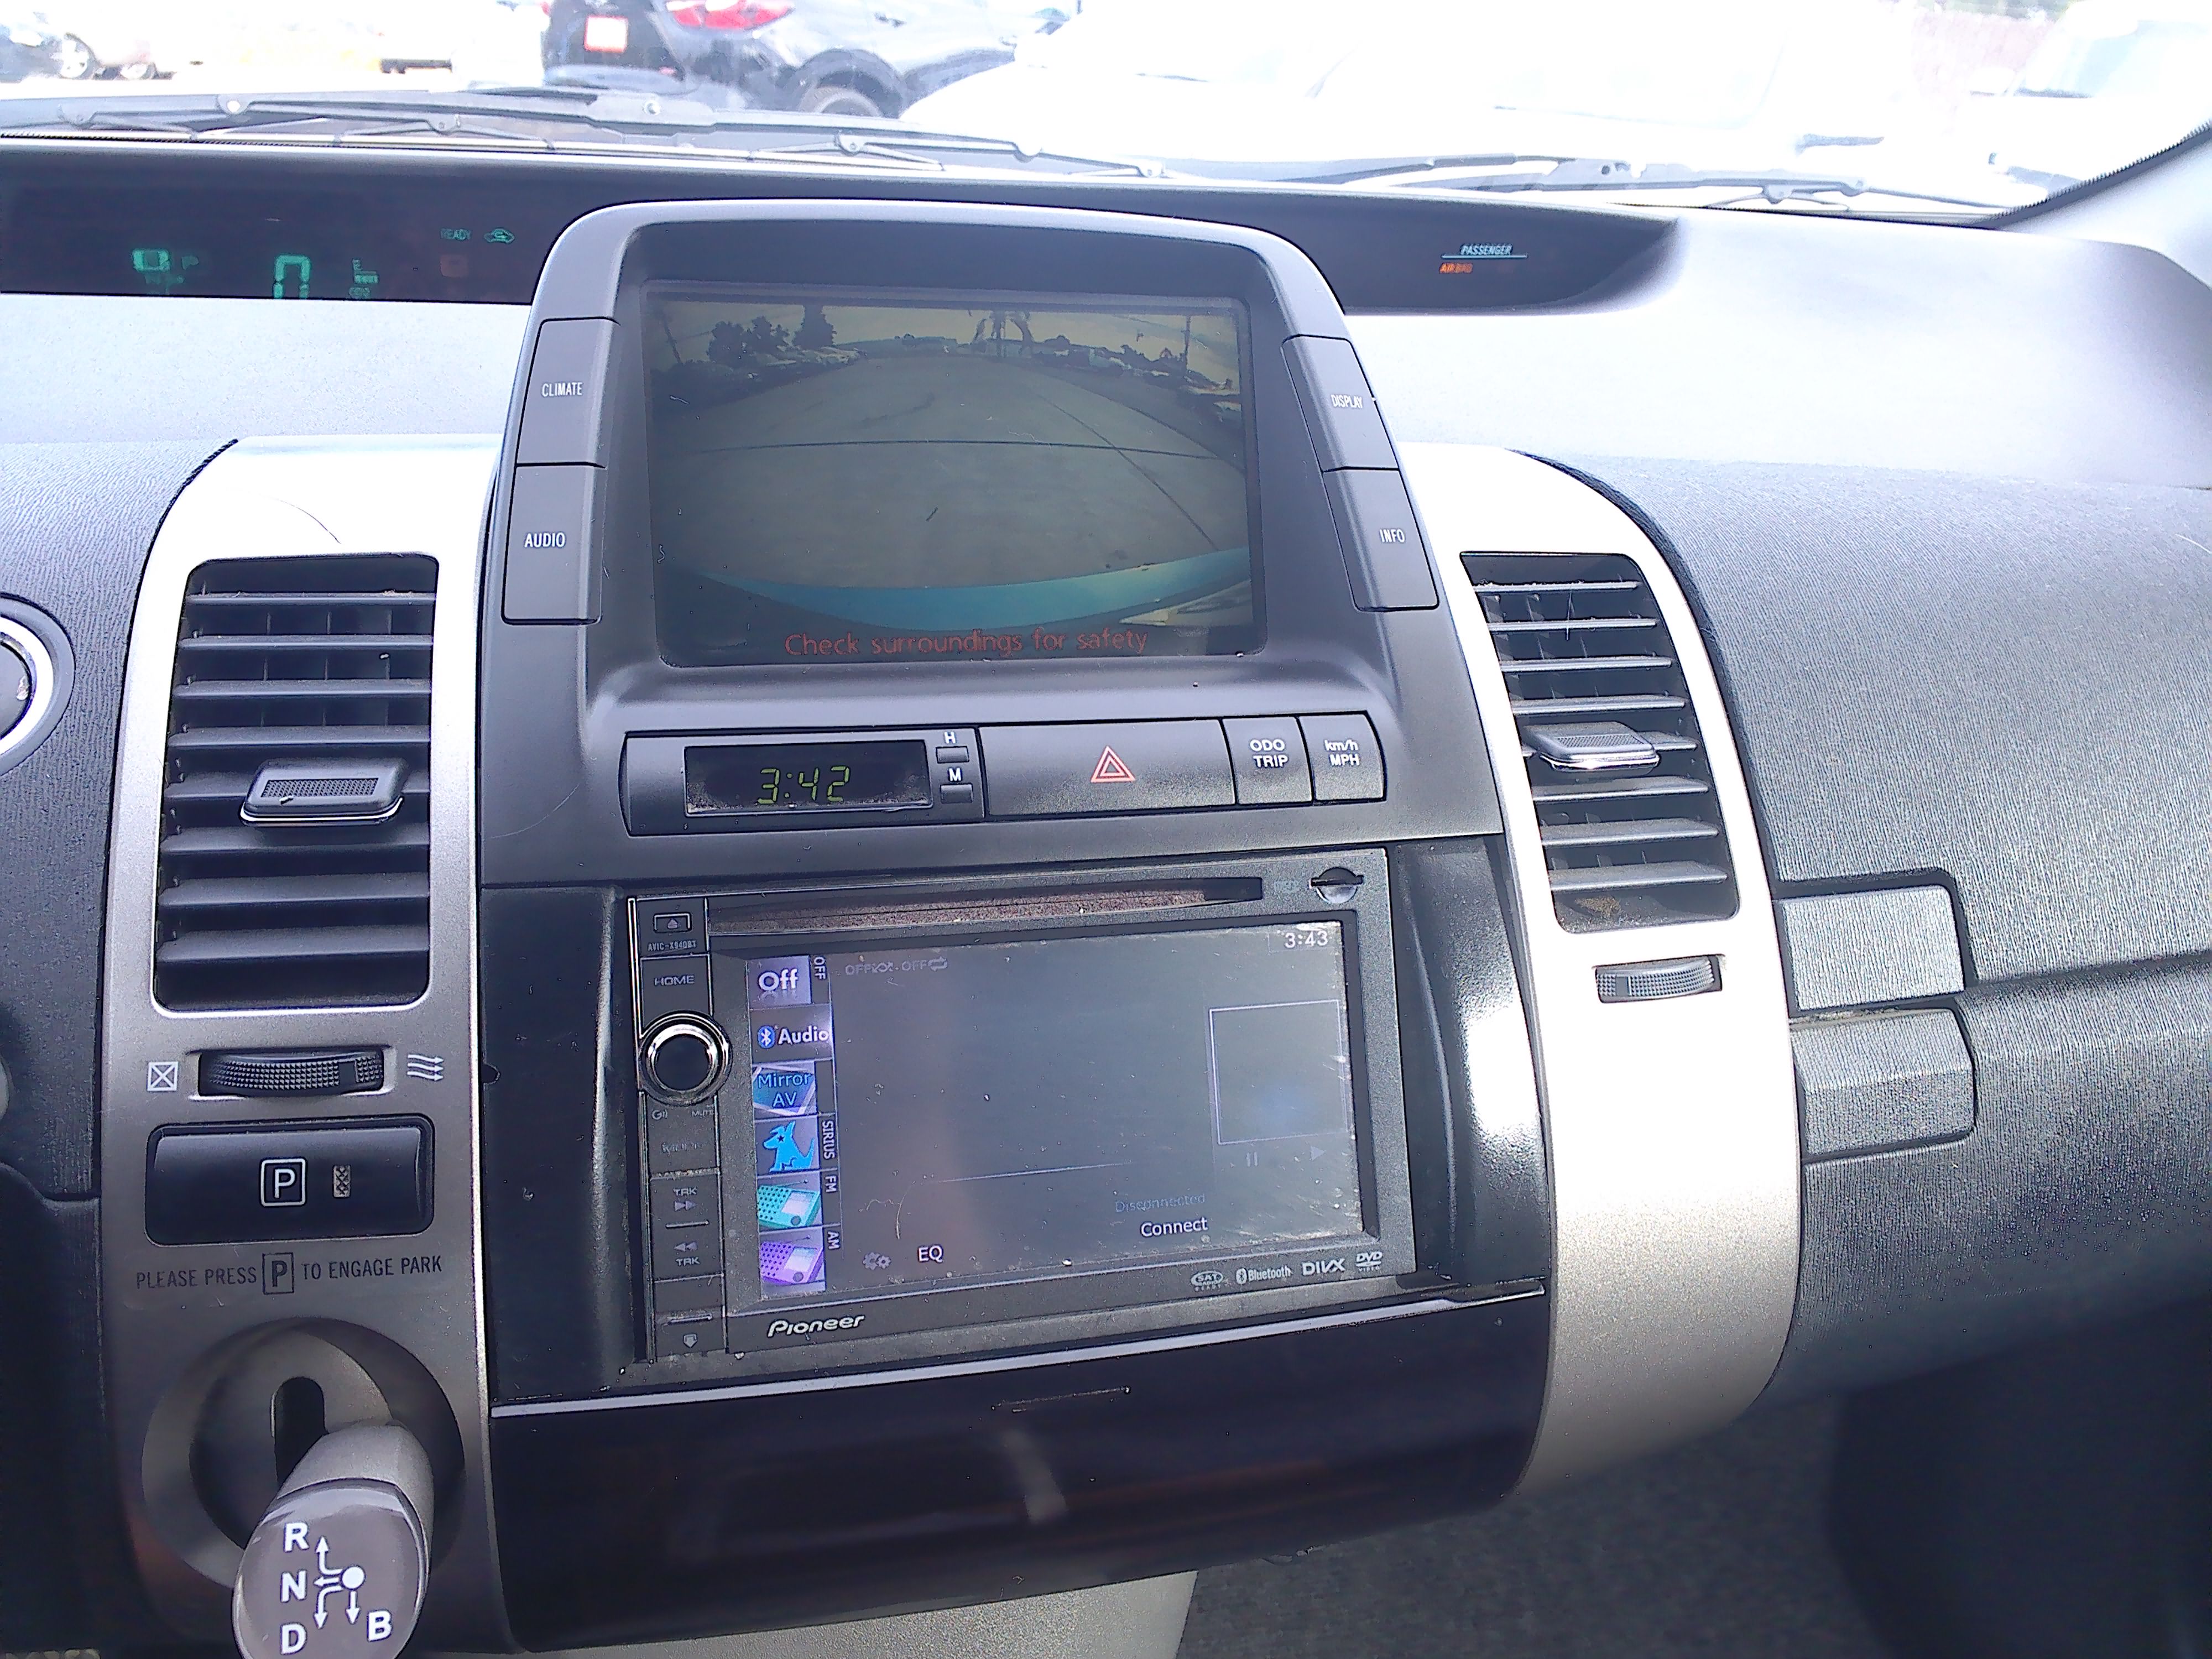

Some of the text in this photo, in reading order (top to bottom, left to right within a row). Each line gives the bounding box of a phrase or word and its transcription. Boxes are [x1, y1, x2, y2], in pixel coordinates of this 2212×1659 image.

[1460, 244, 1513, 255] PASSENGER
[542, 382, 583, 397] CLIMATE
[1331, 394, 1363, 409] DISPLAY
[524, 532, 566, 548] AUDIO
[1380, 529, 1405, 544] INFO
[784, 626, 1149, 658] Check surroundings for safety
[944, 732, 957, 744] H
[1249, 739, 1286, 752] ODO
[1324, 739, 1359, 752] km/h
[1253, 754, 1288, 768] TRIP
[1329, 754, 1360, 766] MPH
[948, 768, 962, 782] M
[758, 765, 851, 805] 3:42
[1284, 930, 1328, 948] 3:43
[813, 956, 827, 980] OFF
[654, 974, 695, 986] HOME
[758, 968, 799, 992] Off
[778, 1025, 830, 1045] Audio
[757, 1072, 812, 1088] Mirror
[773, 1092, 798, 1108] AV
[821, 1120, 836, 1160] SIRIUS
[274, 1168, 296, 1199] P
[674, 1187, 698, 1196] TRK
[825, 1175, 837, 1194] FM
[1114, 1193, 1206, 1213] Disconnected
[1140, 1217, 1209, 1238] Connect
[827, 1231, 841, 1250] AM
[676, 1256, 701, 1266] TRK
[918, 1245, 944, 1263] EQ
[1356, 1251, 1383, 1262] DVD
[136, 1255, 442, 1290] PLEASE PRESS P TO ENGAGE PARK
[1196, 1273, 1219, 1281] SAT
[1248, 1265, 1292, 1282] Bluetooth
[768, 1314, 865, 1338] Pioneer
[284, 1522, 310, 1553] R
[280, 1569, 307, 1603] N
[367, 1609, 393, 1642] B
[280, 1622, 307, 1655] D
